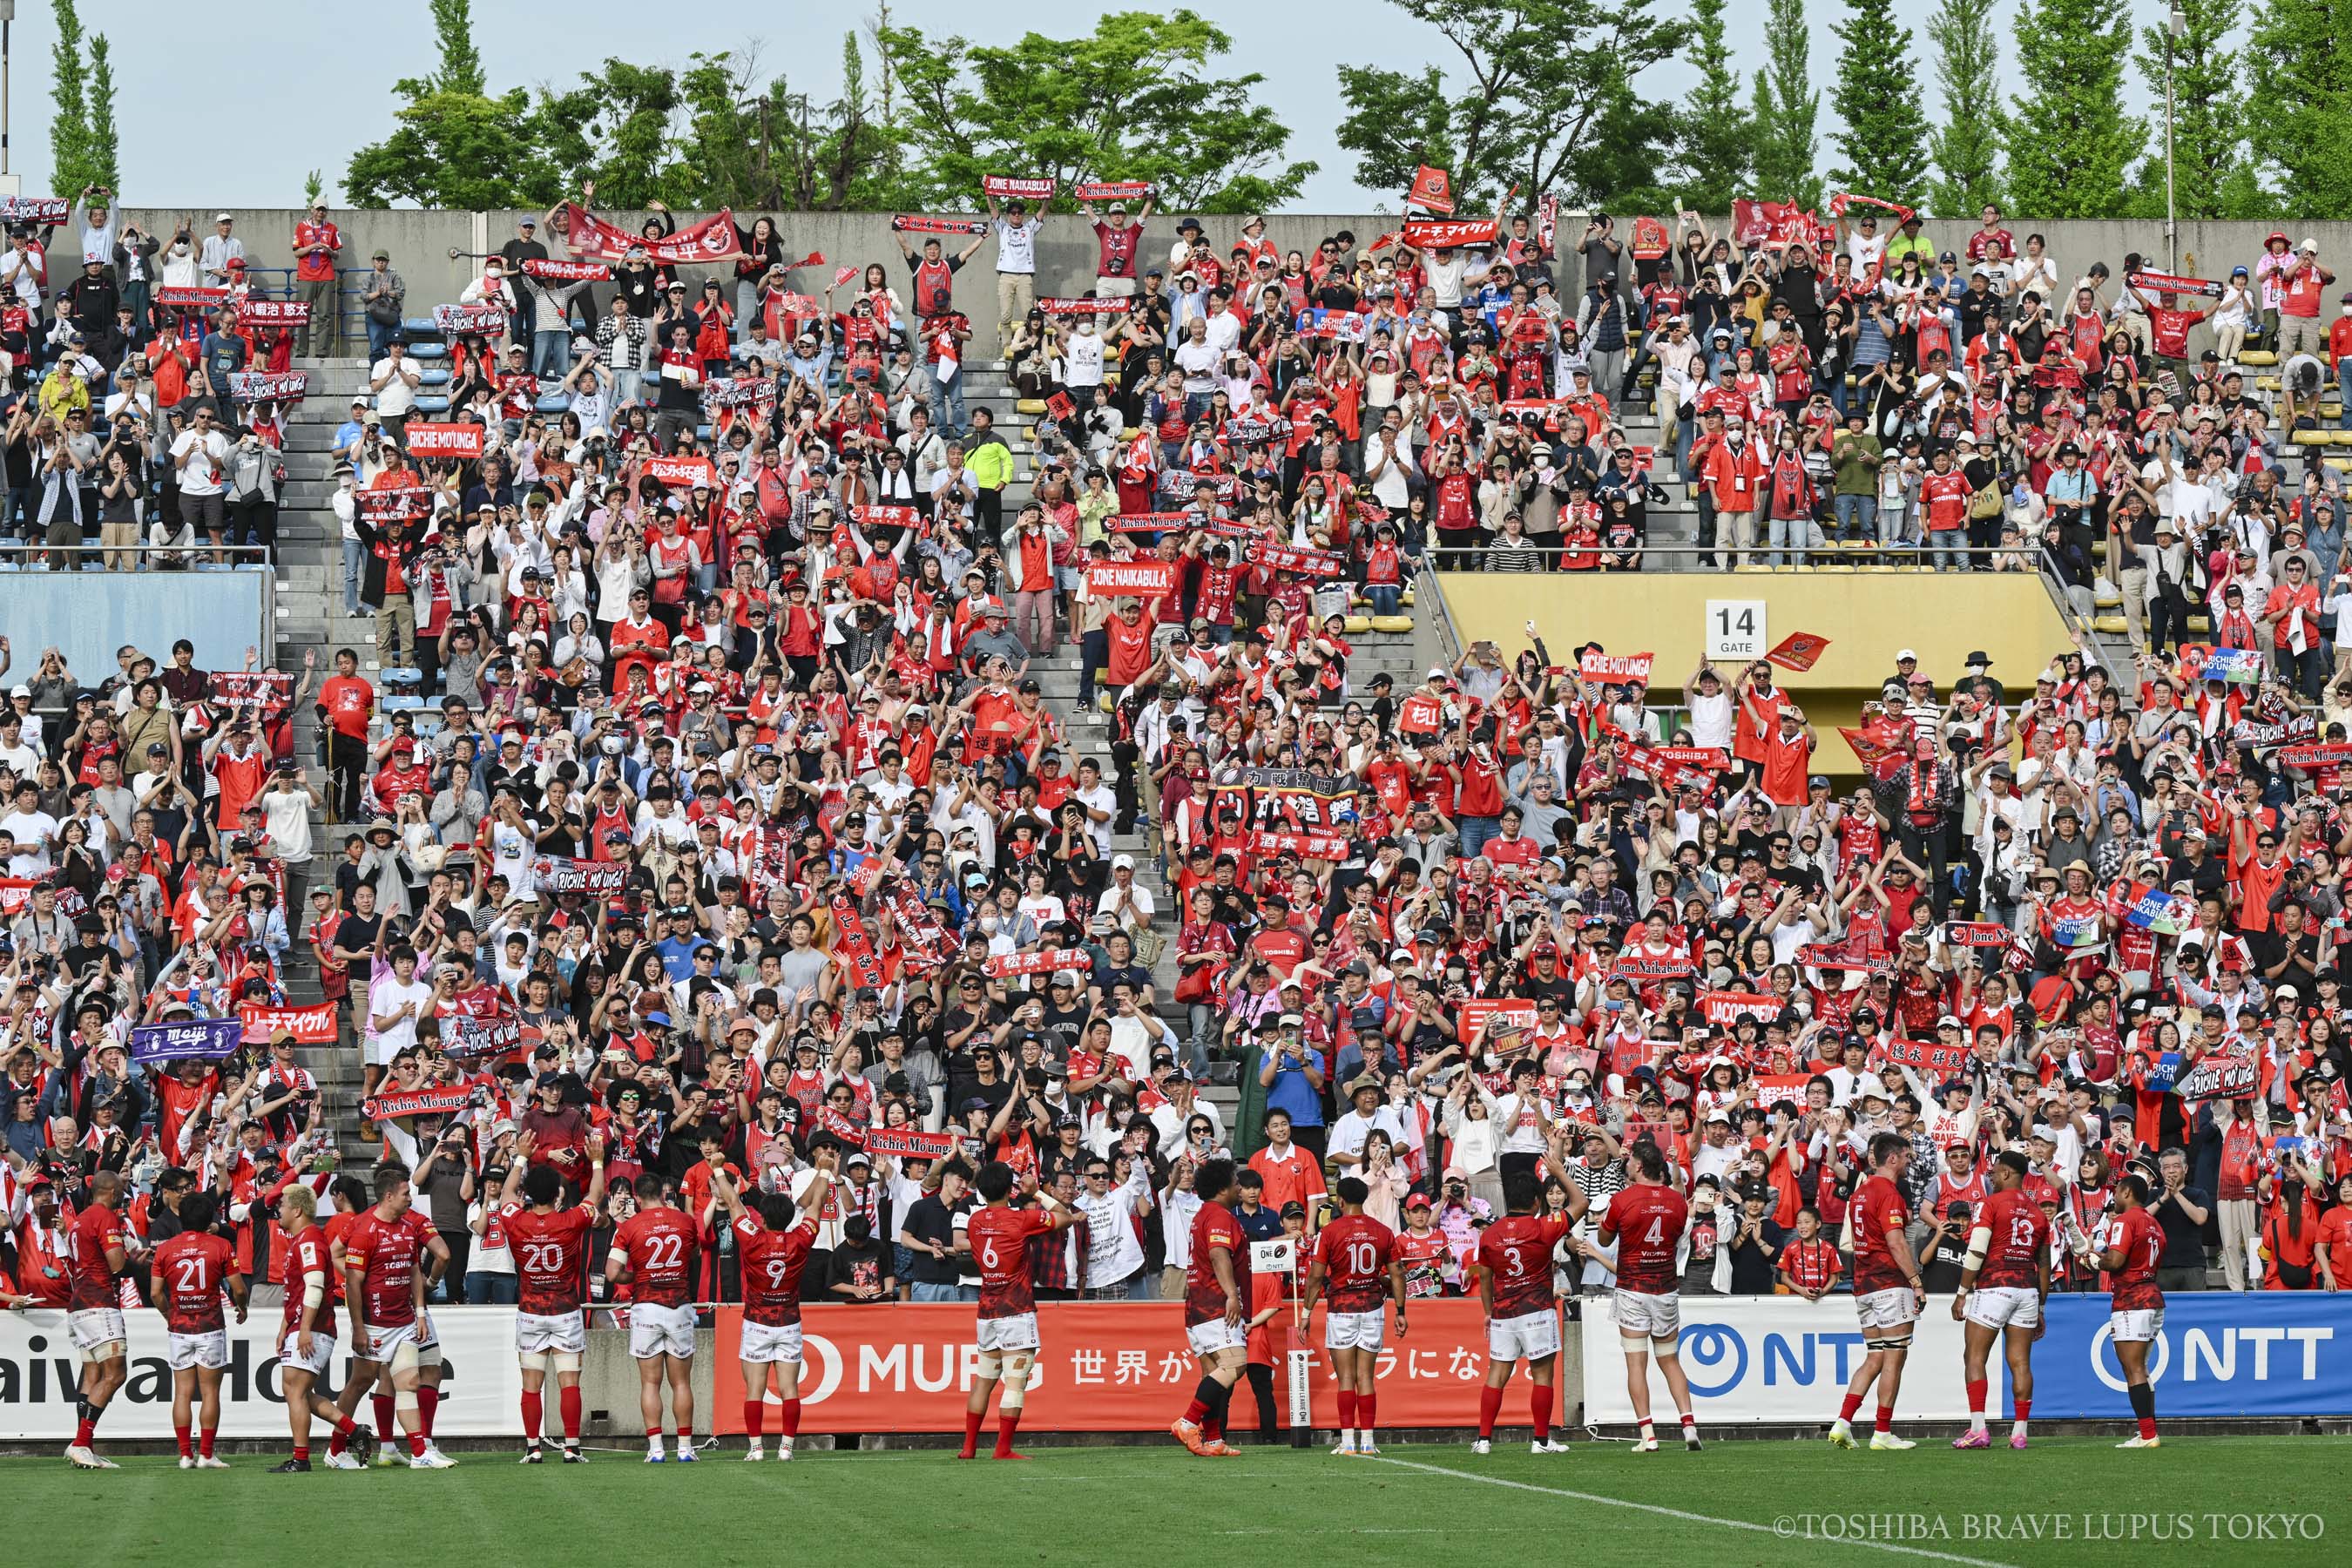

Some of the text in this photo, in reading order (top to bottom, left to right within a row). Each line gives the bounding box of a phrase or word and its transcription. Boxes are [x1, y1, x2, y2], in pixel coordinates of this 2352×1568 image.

[989, 177, 1051, 193] JONE NAIKABULA
[1086, 186, 1110, 197] Richie
[19, 201, 67, 220] RICHIE MO'UNGA
[1409, 221, 1493, 236] リーチ マイケル
[2143, 276, 2169, 287] Richie
[163, 291, 221, 304] Richie Mo'unga
[453, 314, 474, 331] RICHIE
[254, 380, 276, 400] RICHIE
[727, 389, 752, 405] MICHAEL
[410, 430, 477, 449] RICHIE MO'UNGA
[1248, 427, 1269, 441] RICHIE
[1120, 514, 1147, 528] Richie
[1149, 512, 1186, 528] Mo'unga
[1092, 569, 1166, 588] JONE NAIKABULA
[1716, 607, 1755, 636] 14
[1720, 642, 1753, 652] GATE
[1581, 653, 1650, 677] RICHIE MO'UNGA
[2207, 654, 2234, 663] RICHIE
[2260, 724, 2285, 743] RICHIE
[1659, 751, 1709, 760] TOSHIBA
[1247, 770, 1333, 795] 力戦奮闘
[1260, 834, 1297, 849] 酒木
[558, 870, 624, 889] RICHIE MO'UNGA
[2139, 896, 2162, 911] JONE
[1970, 928, 1993, 943] Jone
[1003, 952, 1042, 968] 松永
[1638, 960, 1689, 975] Naikabula
[470, 1030, 491, 1051] RICHIE
[2193, 1064, 2255, 1095] RICHIE MO'UNGA
[381, 1092, 467, 1115] Richie Mo'unga
[871, 1133, 906, 1150] Richie
[1854, 1205, 1865, 1236] 5
[1644, 1215, 1665, 1247] 4
[1697, 1232, 1710, 1247] 10
[2011, 1216, 2035, 1247] 13
[523, 1243, 563, 1273] 20
[645, 1233, 682, 1269] 22
[983, 1237, 998, 1268] 6
[1260, 1249, 1274, 1259] ONE
[1347, 1242, 1376, 1274] 10
[1505, 1247, 1524, 1277] 3
[177, 1257, 207, 1291] 21
[766, 1260, 787, 1289] 9
[2183, 1328, 2334, 1382] NTT
